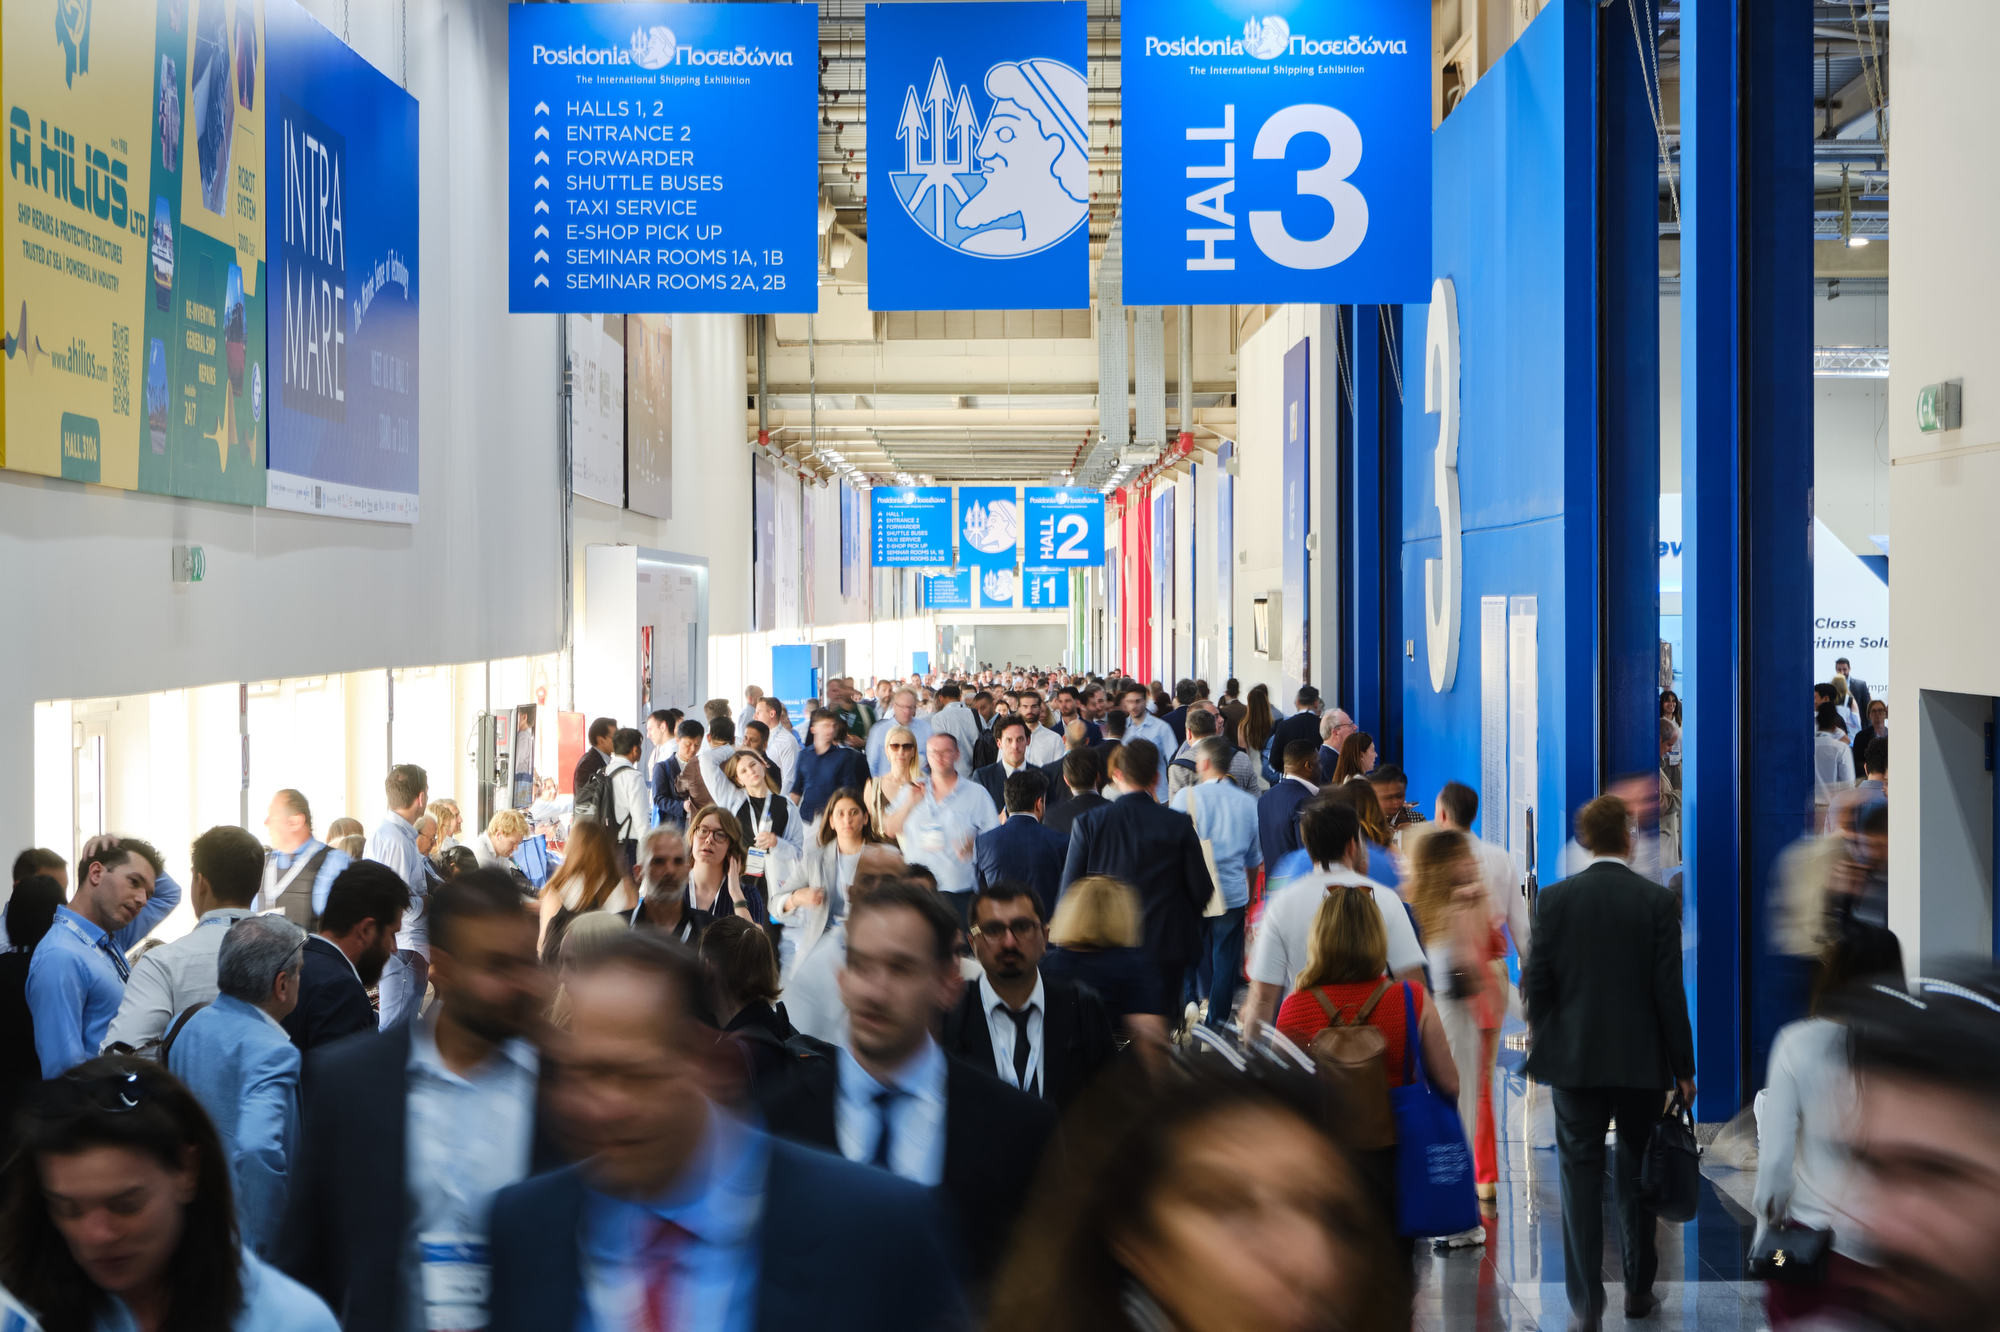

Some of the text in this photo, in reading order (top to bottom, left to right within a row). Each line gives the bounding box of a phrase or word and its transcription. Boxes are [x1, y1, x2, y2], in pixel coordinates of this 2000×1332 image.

[532, 45, 630, 66] Posidonia
[675, 45, 793, 66] Ποσειδώνια
[1145, 35, 1243, 56] Posidonia
[1289, 35, 1407, 56] Ποσειδώνια
[576, 75, 750, 86] The International Shipping Exhibition
[1189, 65, 1365, 76] The International Shipping Exhibition
[567, 101, 664, 118] HALLS 1, 2
[567, 126, 691, 141] ENTRANCE 2
[567, 151, 694, 166] FORWARDER
[238, 165, 255, 194] ROBOT
[566, 175, 723, 191] SHUTTLE BUSES
[1186, 104, 1369, 271] HALL 3
[284, 119, 344, 271] INTRA
[238, 192, 256, 222] SYSTEM
[567, 200, 697, 215] TAXI SERVICE
[18, 202, 31, 226] SHIP
[32, 208, 54, 237] REPAIRS
[60, 220, 91, 251] PROTECTIVE
[92, 234, 122, 264] STRUCTURES
[130, 208, 146, 239] LTD
[567, 225, 722, 240] E-SHOP PICK UP
[22, 239, 45, 265] TRUSTED
[53, 251, 62, 271] SEA
[66, 256, 91, 283] POWERFUL
[97, 270, 119, 293] INDUSTRY
[566, 249, 784, 267] SEMINAR ROOMS 1A, 1B
[566, 274, 786, 292] SEMINAR ROOMS 2A, 2B
[285, 257, 344, 401] MARE
[64, 431, 81, 459] HALL
[1425, 278, 1462, 693] 3
[1040, 514, 1089, 559] HALL 2
[1031, 575, 1056, 604] HALL 1
[1815, 618, 1856, 629] Class
[1814, 636, 1855, 649] itime
